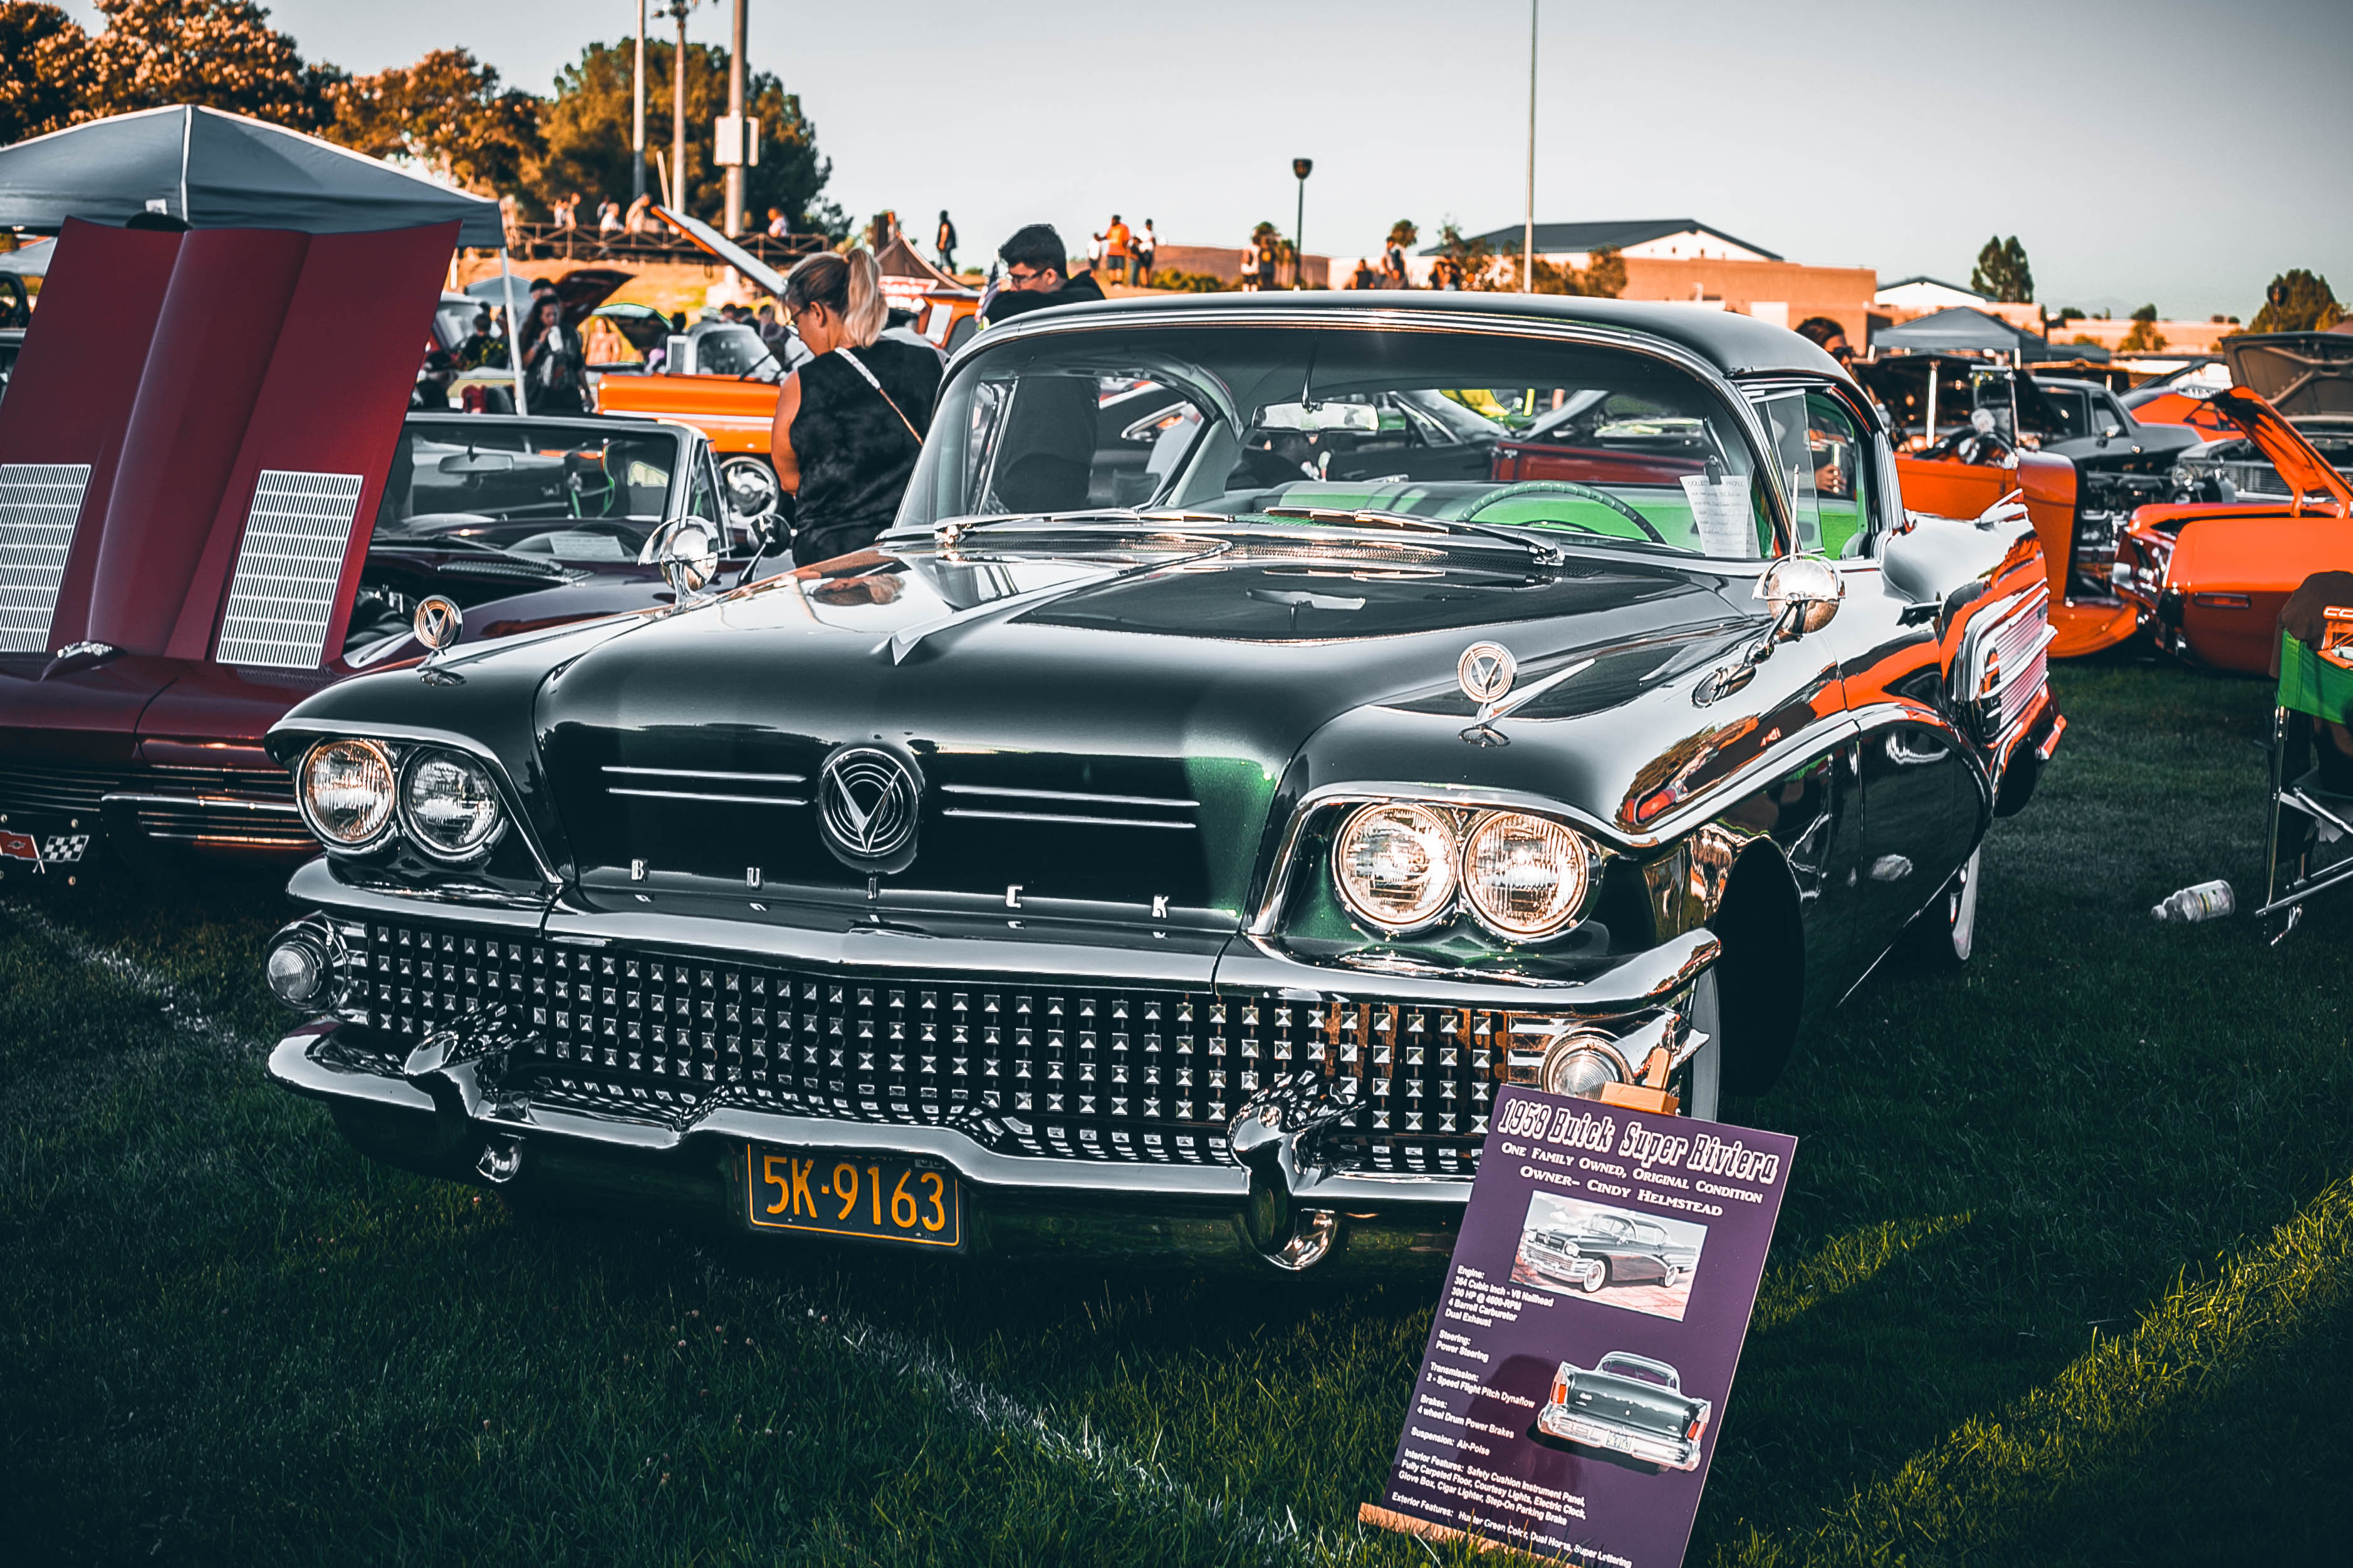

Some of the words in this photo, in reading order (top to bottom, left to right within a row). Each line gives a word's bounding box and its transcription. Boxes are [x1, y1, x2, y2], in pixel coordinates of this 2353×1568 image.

[631, 859, 1169, 919] BUICK
[1498, 1098, 1552, 1140] 1958
[1547, 1108, 1615, 1153] Buick
[1619, 1121, 1688, 1168] Super
[1686, 1134, 1779, 1184] Riviera
[1501, 1142, 1526, 1156] ONE
[1531, 1148, 1574, 1166] FAMILY
[1579, 1158, 1627, 1178] OWNED,
[1633, 1168, 1689, 1189] ORIGINAL
[1696, 1181, 1763, 1203] CONDITION
[1520, 1166, 1580, 1186] OWNER-
[1587, 1180, 1631, 1197] CINDY
[1637, 1189, 1723, 1215] HELMSTEAD
[1458, 1265, 1484, 1279] Engine:
[1451, 1287, 1464, 1297] 300
[1465, 1290, 1476, 1299] HP
[1476, 1293, 1485, 1304] @
[1468, 1279, 1489, 1291] Cubic
[1490, 1284, 1506, 1295] Inch
[1511, 1289, 1521, 1299] V8
[1521, 1292, 1554, 1307] Nailhead
[1445, 1308, 1462, 1319] Dual
[1463, 1312, 1491, 1327] Exhaust
[1479, 1305, 1517, 1321] Carburetor
[1436, 1340, 1459, 1353] Power
[1459, 1346, 1489, 1363] Steering
[1439, 1329, 1471, 1346] Steering:
[1431, 1362, 1479, 1382] Transmission:
[1421, 1394, 1448, 1409] Brakes:
[1426, 1373, 1432, 1381] 2
[1437, 1375, 1459, 1388] Speed
[1460, 1381, 1481, 1394] Flight
[1481, 1387, 1500, 1399] Pitch
[1501, 1392, 1535, 1408] Dynaflow
[1417, 1405, 1422, 1413] 4
[1424, 1408, 1444, 1420] wheel
[1444, 1412, 1464, 1425] Drum
[1465, 1418, 1488, 1431] Power
[1489, 1424, 1514, 1438] Brakes
[1411, 1426, 1454, 1446] Suspension:
[1457, 1440, 1490, 1455] Air-Poise
[1402, 1459, 1419, 1473] Fully
[1421, 1465, 1453, 1480] Carpeted
[1453, 1473, 1472, 1488] Floor,
[1474, 1480, 1507, 1497] Courtesy
[1508, 1489, 1532, 1504] Lights,
[1534, 1497, 1562, 1512] Electric
[1563, 1505, 1585, 1520] Clock,
[1405, 1448, 1431, 1462] Interior
[1431, 1455, 1464, 1472] Features:
[1467, 1466, 1490, 1481] Safety
[1491, 1472, 1521, 1488] Cushion
[1522, 1481, 1562, 1500] Instrument
[1563, 1492, 1585, 1507] Panel,
[1399, 1470, 1419, 1483] Glove
[1420, 1476, 1435, 1489] Box,
[1437, 1482, 1456, 1493] Cigar
[1458, 1487, 1483, 1503] Lighter,
[1486, 1495, 1515, 1510] Step-On
[1516, 1503, 1544, 1520] Parking
[1545, 1512, 1567, 1525] Brake
[1392, 1492, 1420, 1505] Exterior
[1421, 1500, 1453, 1517] Features:
[1484, 1519, 1506, 1532] Green
[1530, 1532, 1548, 1544] Dual
[1573, 1544, 1597, 1559] Super
